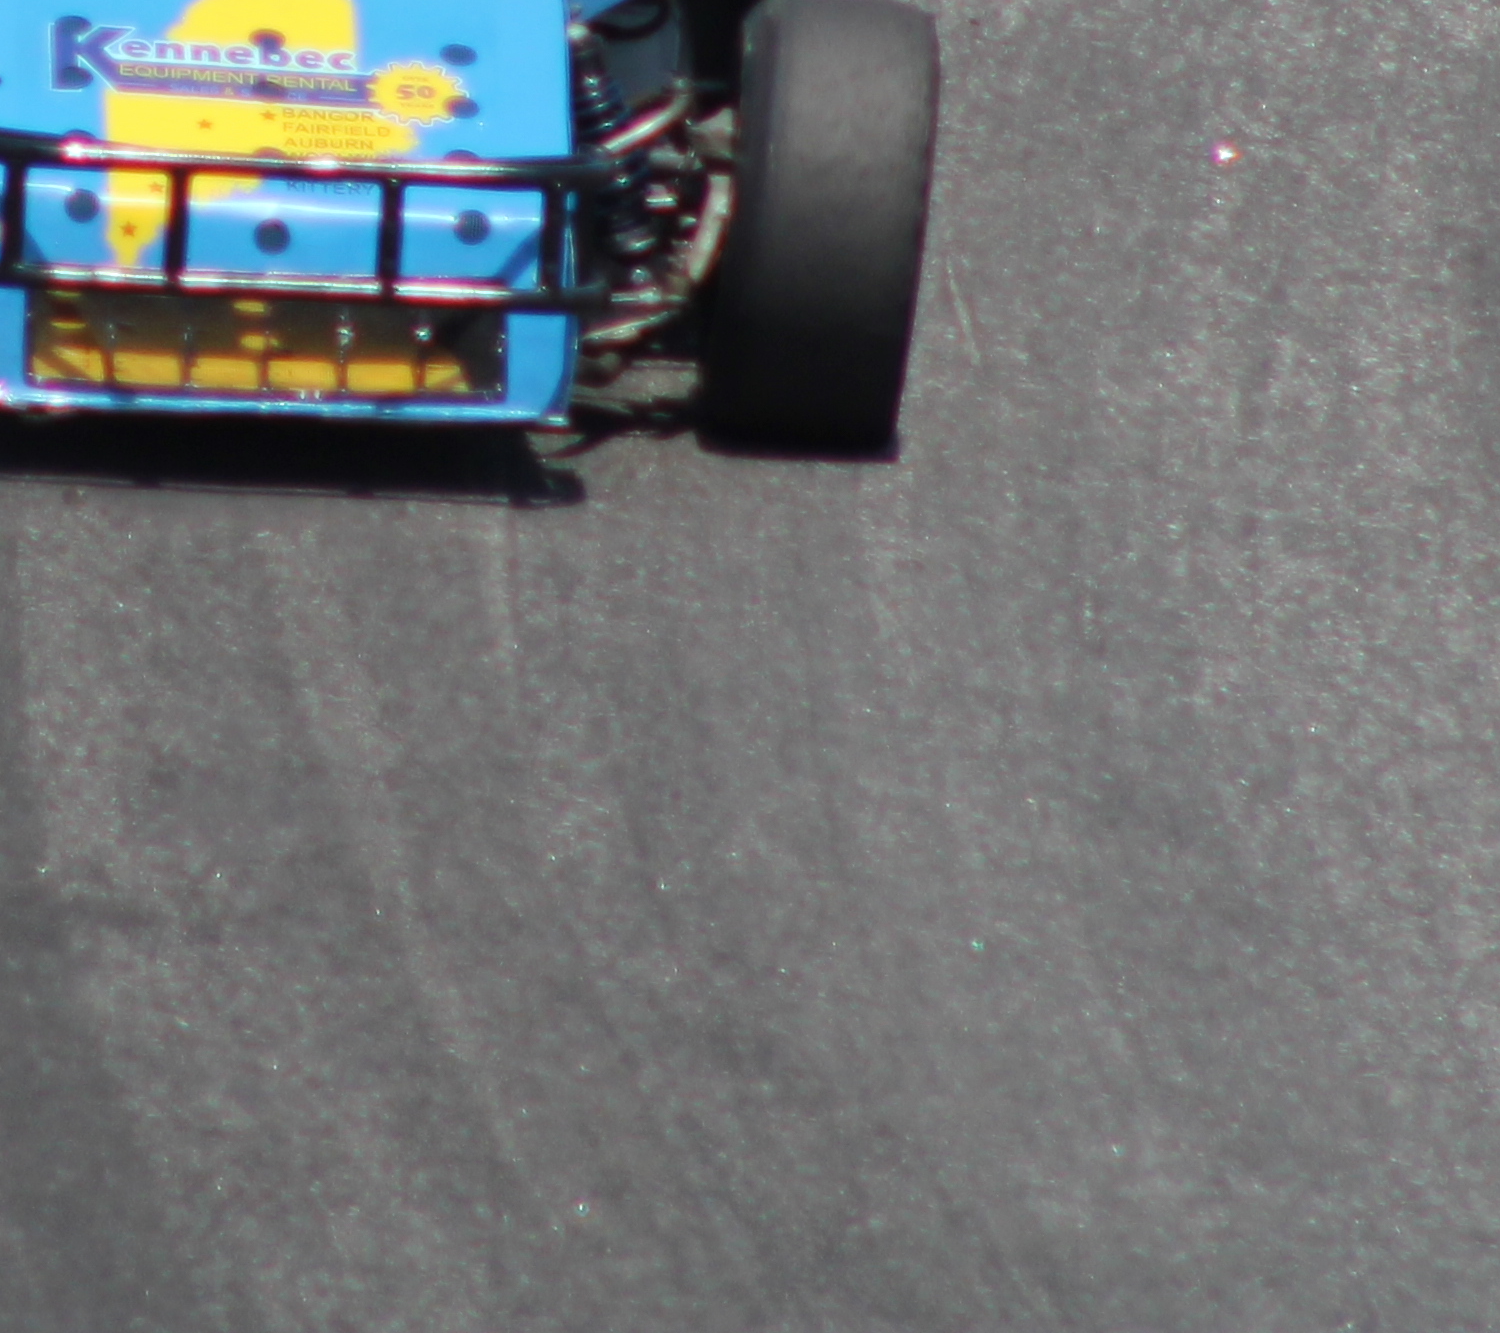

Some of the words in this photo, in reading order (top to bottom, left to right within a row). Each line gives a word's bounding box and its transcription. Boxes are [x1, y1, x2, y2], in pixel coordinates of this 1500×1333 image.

[50, 22, 358, 92] Kennebec
[118, 63, 262, 86] EQUIPMENT
[265, 73, 358, 93] RENTAL
[396, 83, 437, 101] 50
[282, 107, 375, 122] BANGOR
[282, 121, 391, 138] FAIRFIELD
[284, 137, 375, 151] AUBURN
[286, 179, 376, 195] KITTERY
